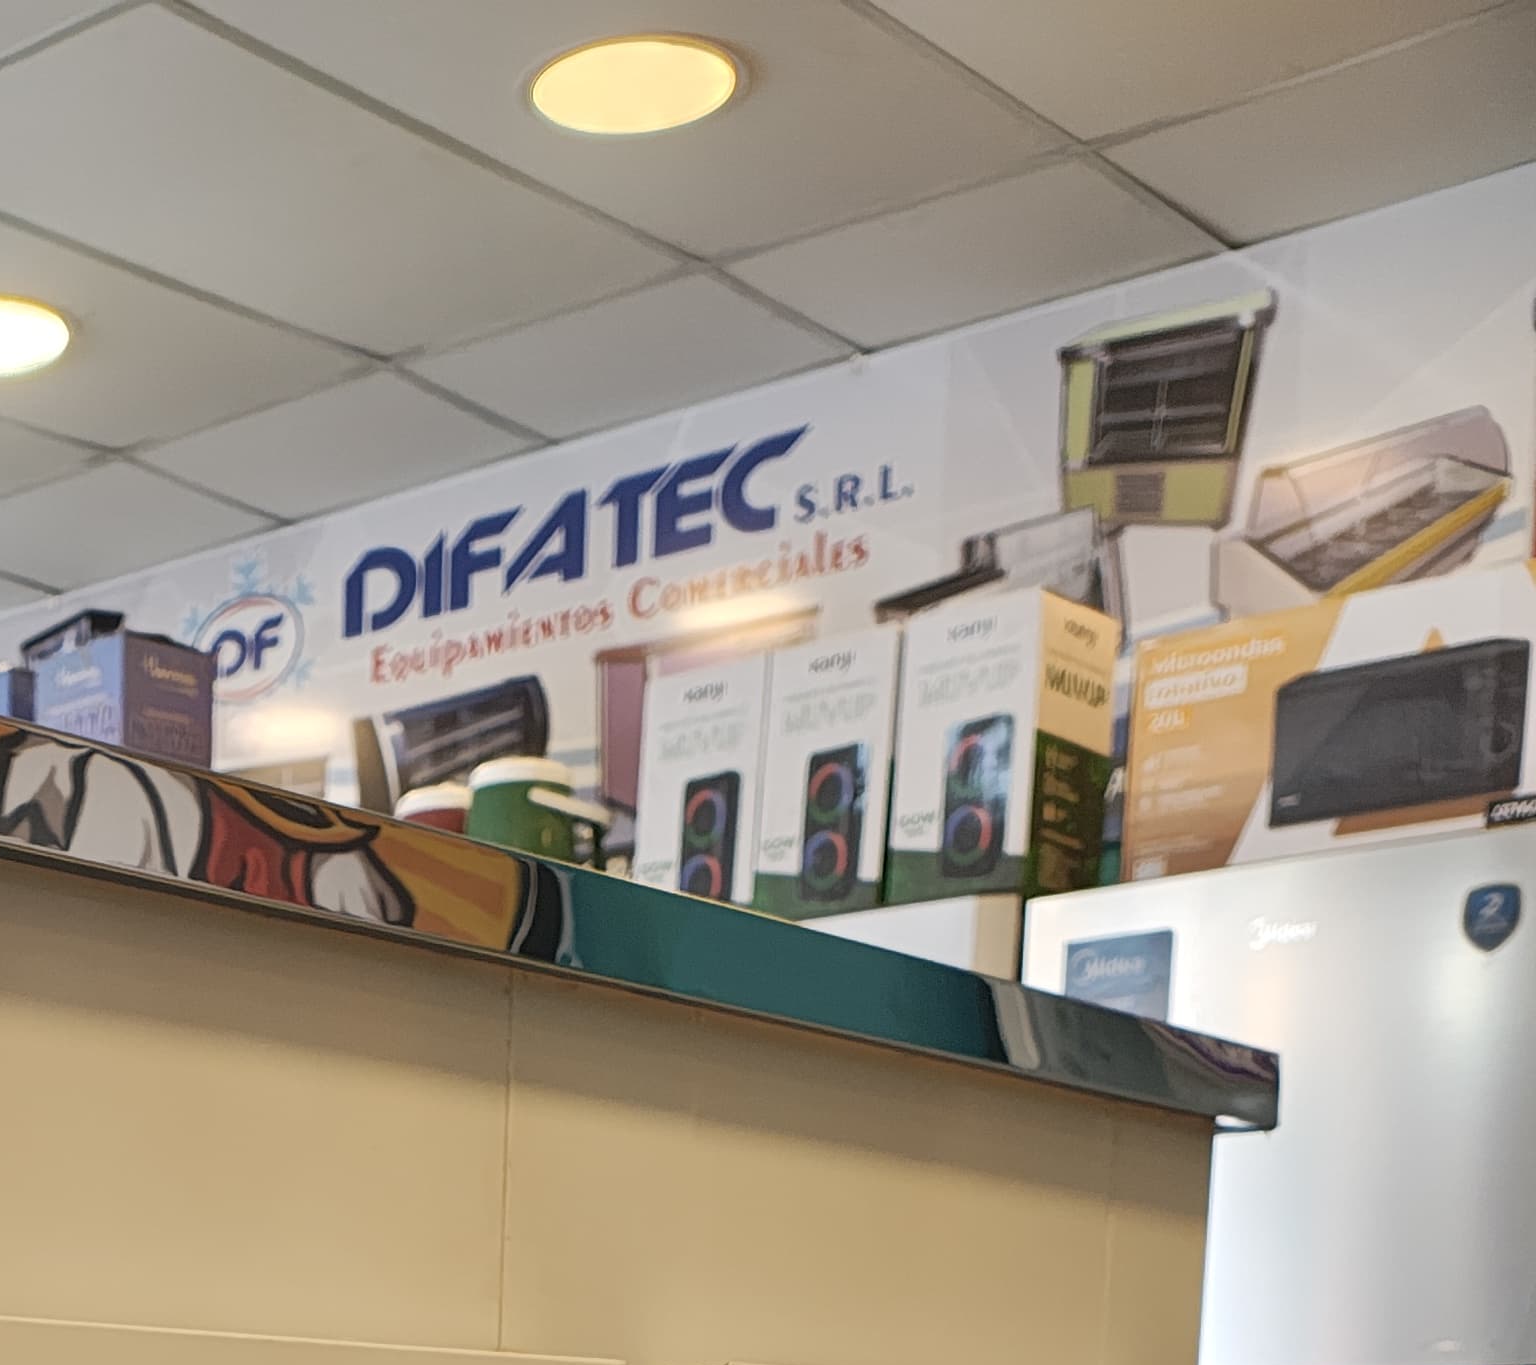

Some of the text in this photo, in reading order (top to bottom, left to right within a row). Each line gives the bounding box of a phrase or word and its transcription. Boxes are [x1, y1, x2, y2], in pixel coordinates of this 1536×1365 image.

[342, 423, 915, 638] DIFATEC S.R.L.
[369, 530, 871, 685] Equipamientos Comerciales
